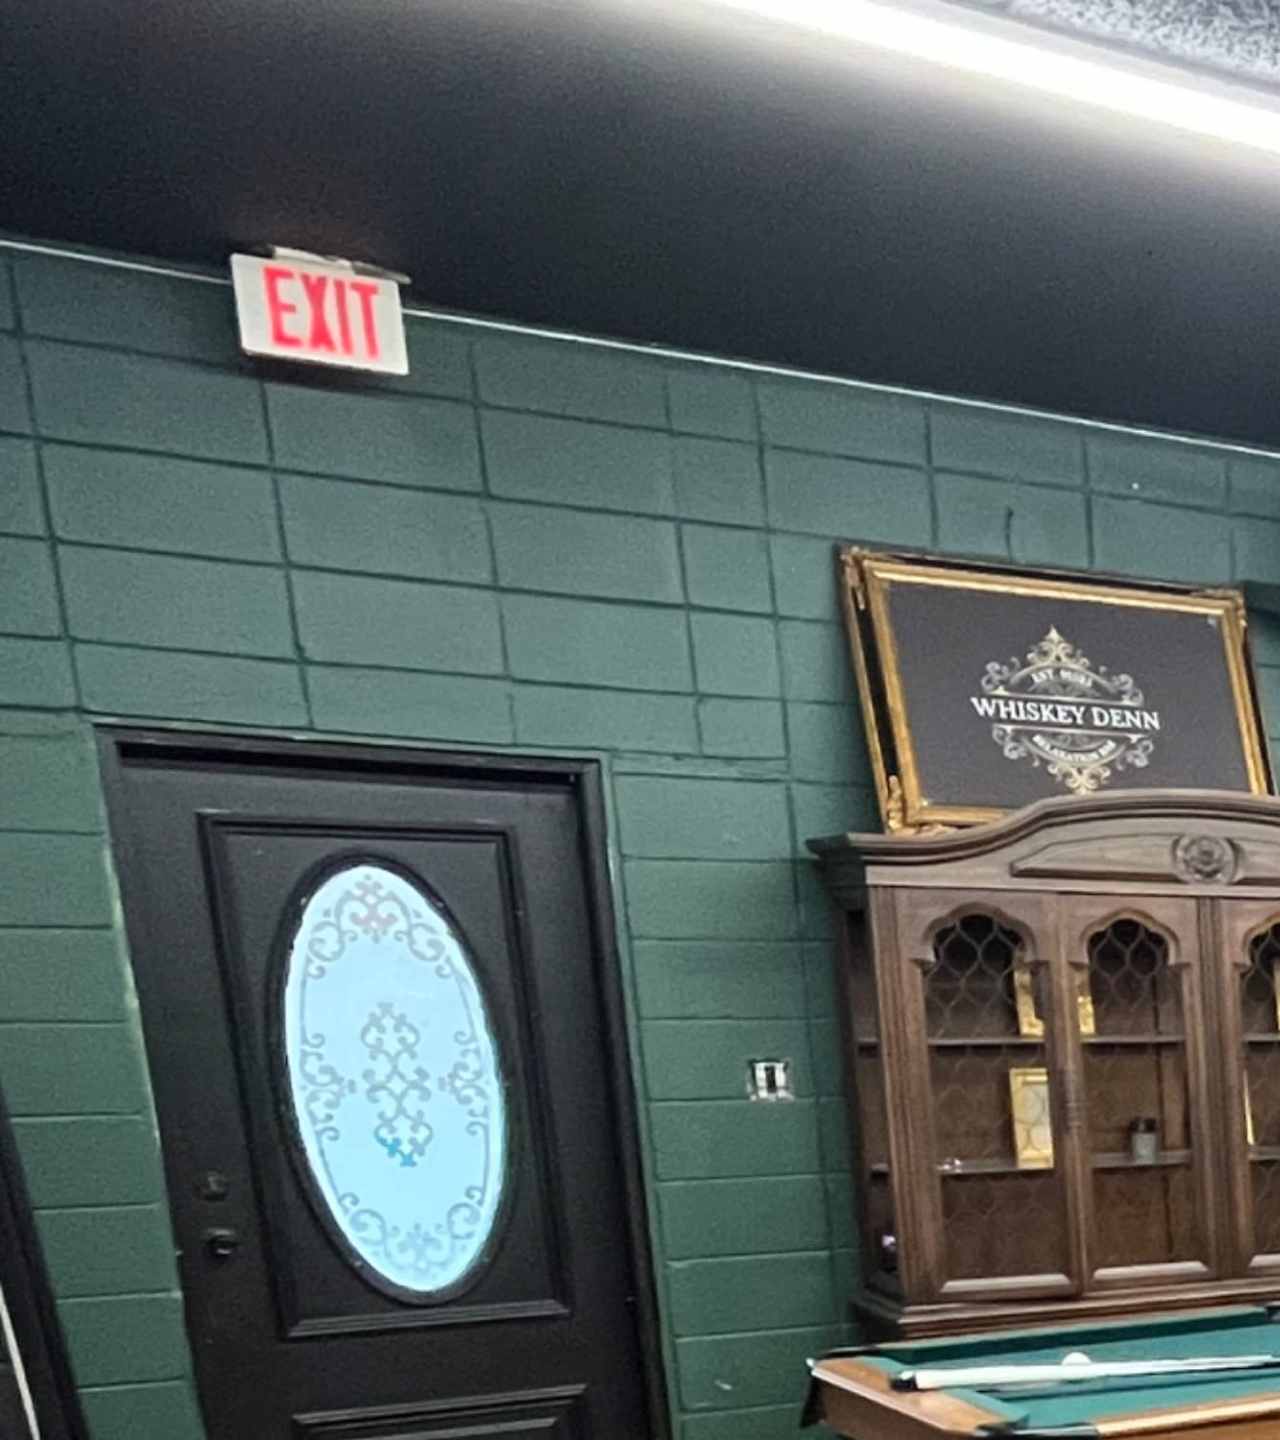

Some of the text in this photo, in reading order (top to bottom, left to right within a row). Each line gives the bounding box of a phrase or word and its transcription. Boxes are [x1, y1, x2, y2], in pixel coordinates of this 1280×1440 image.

[263, 266, 379, 359] EXIT
[970, 697, 1160, 730] WHISKEY DENN
